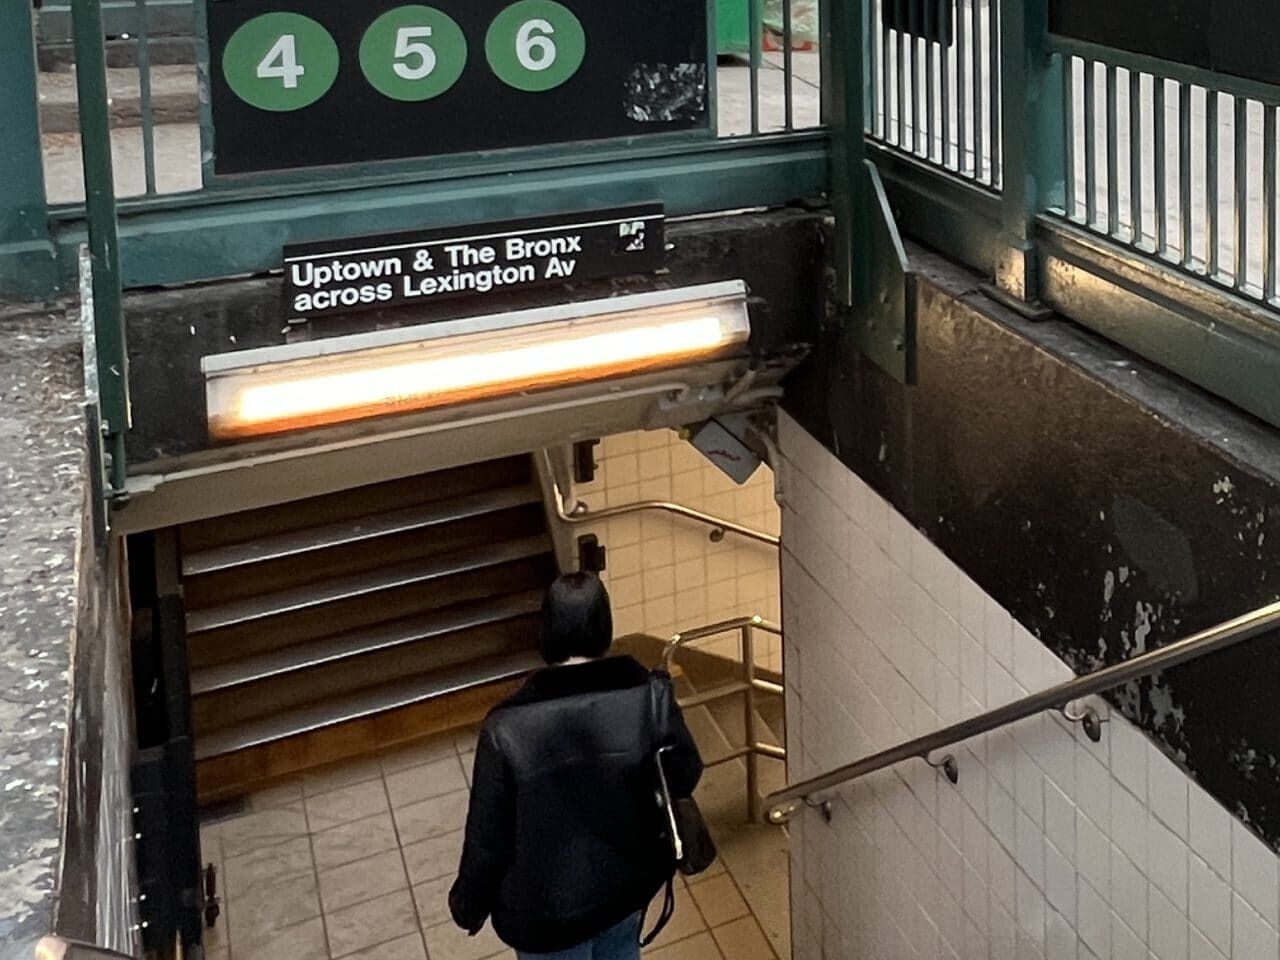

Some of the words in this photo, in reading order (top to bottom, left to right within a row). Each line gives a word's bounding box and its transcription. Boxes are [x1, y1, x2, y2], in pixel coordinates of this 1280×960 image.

[257, 34, 304, 89] 4
[392, 26, 437, 80] 5
[515, 18, 557, 72] 6
[291, 257, 402, 289] Uptown
[413, 249, 434, 272] &
[445, 244, 497, 268] The
[505, 235, 582, 262] Bronx
[293, 282, 393, 312] across
[402, 265, 535, 299] Lexington
[544, 257, 577, 279] Av
